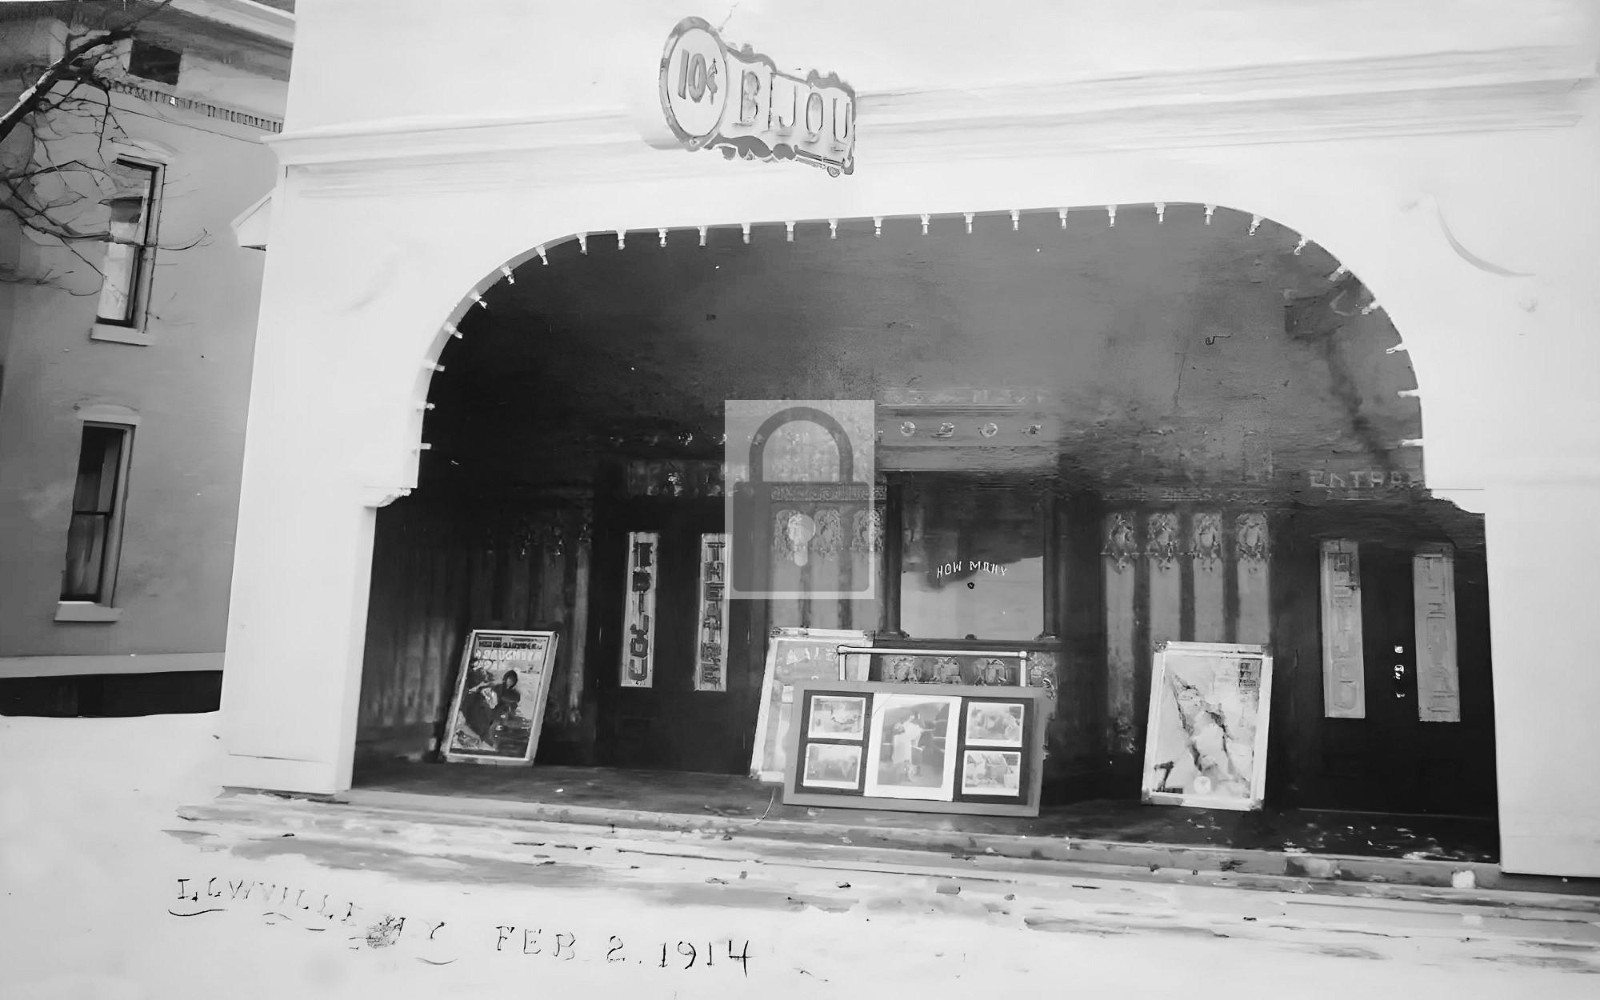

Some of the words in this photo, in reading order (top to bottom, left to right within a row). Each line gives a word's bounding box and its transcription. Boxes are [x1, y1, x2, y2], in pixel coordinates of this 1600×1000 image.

[736, 69, 851, 147] BIJOU
[936, 560, 962, 579] HOW
[495, 925, 576, 961] FEB
[658, 938, 753, 979] 1914
